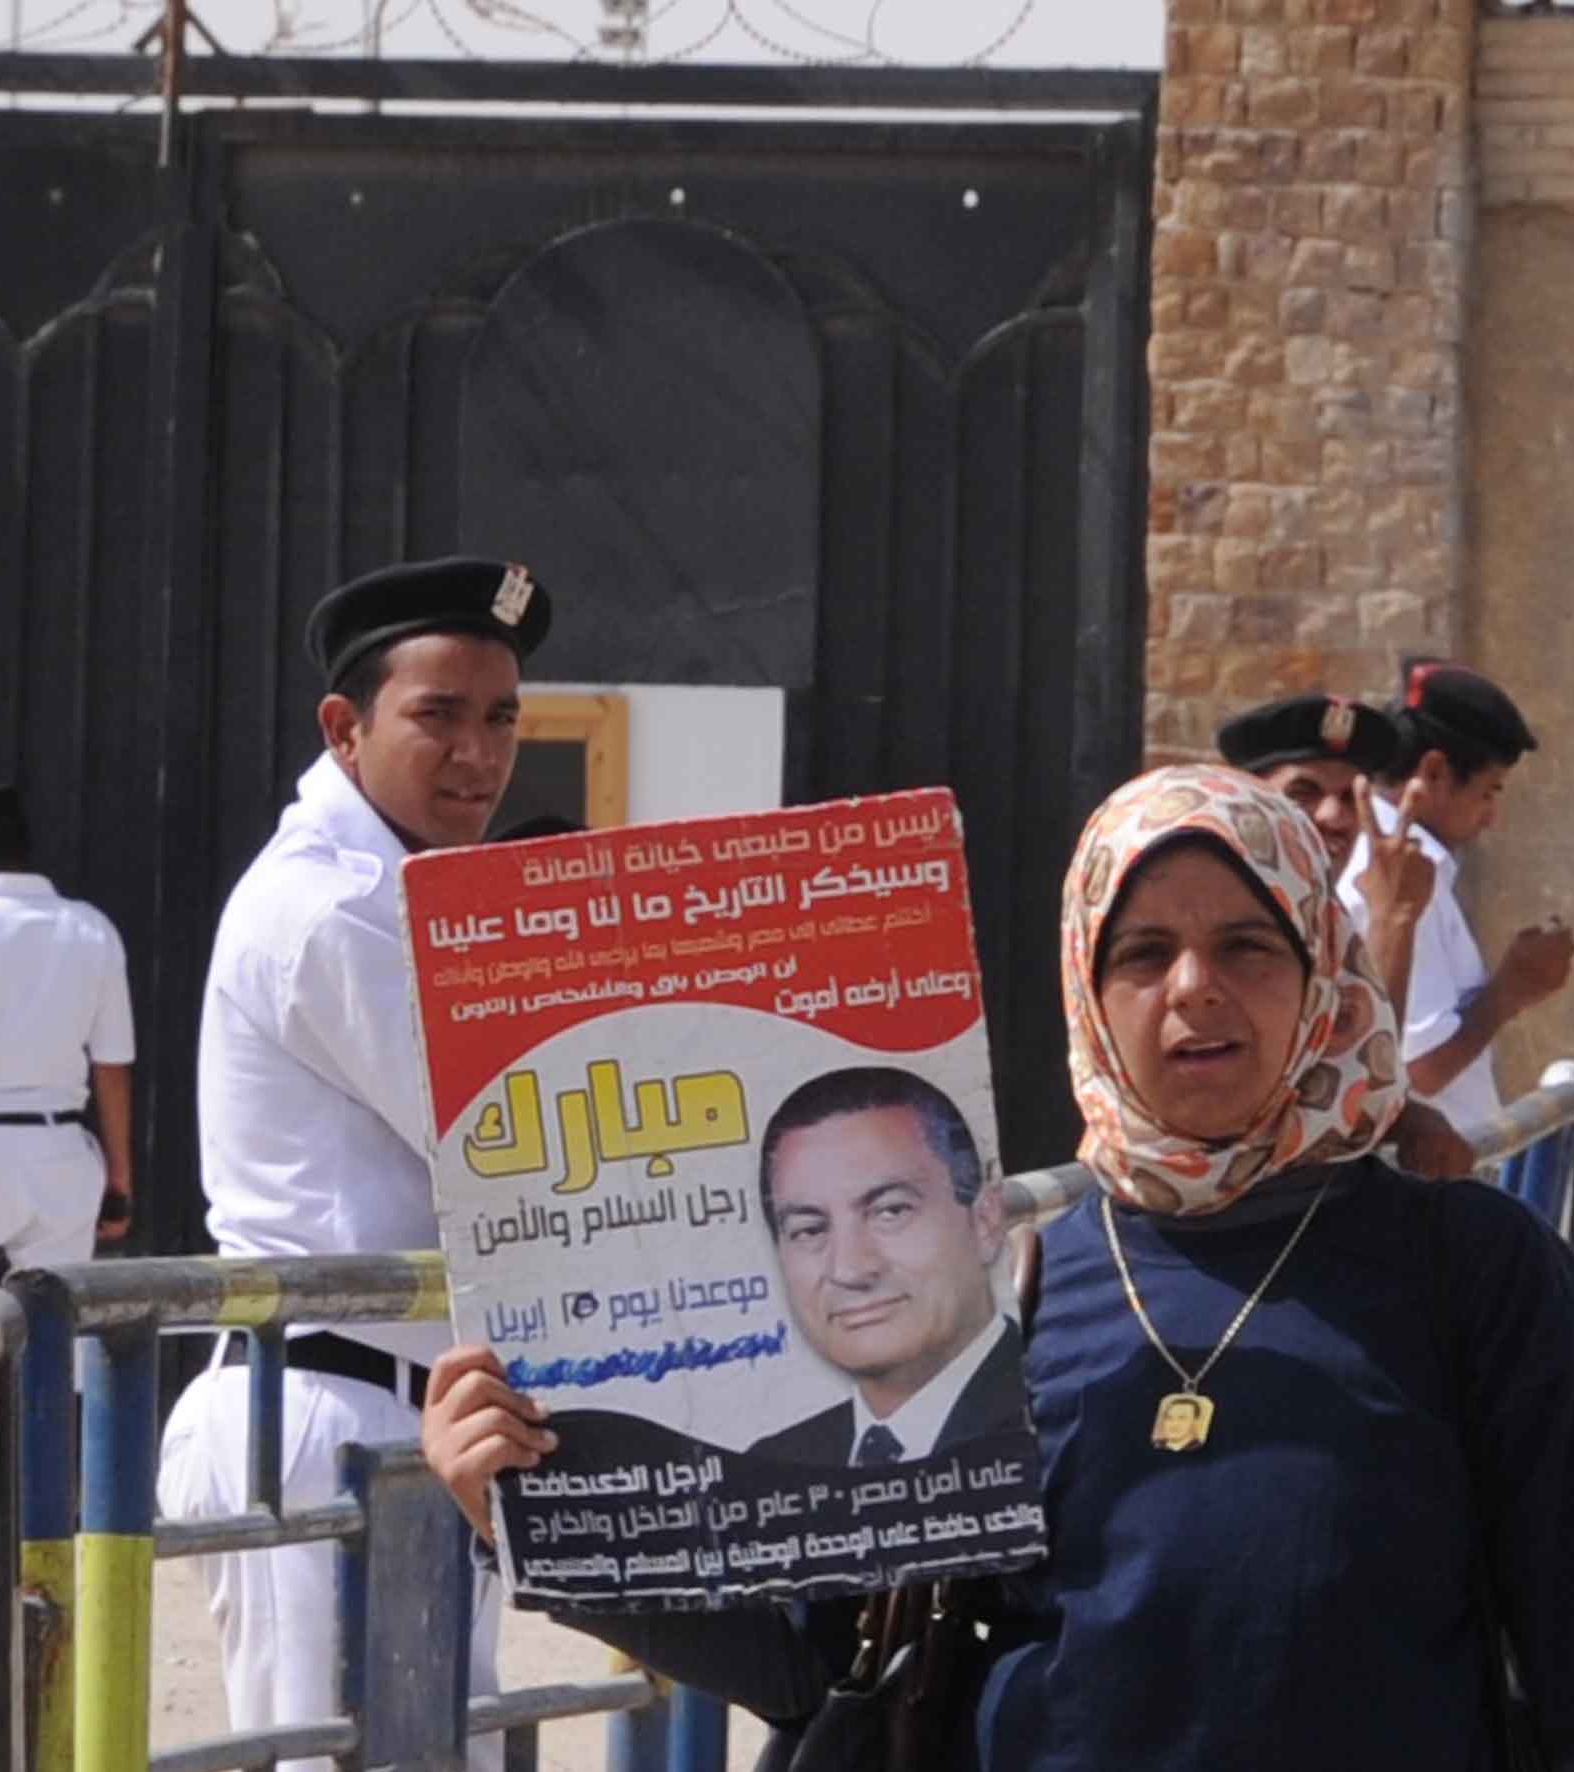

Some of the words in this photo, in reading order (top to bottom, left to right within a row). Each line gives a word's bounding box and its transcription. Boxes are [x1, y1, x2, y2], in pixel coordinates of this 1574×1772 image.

[625, 838, 702, 873] خيانة
[819, 819, 865, 854] من
[684, 873, 785, 923] التاريخ
[799, 858, 950, 909] وسيذكر
[515, 907, 579, 940] وما
[588, 895, 622, 927] لنا
[633, 892, 673, 921] ما
[429, 914, 506, 952] علينا
[695, 961, 766, 989] الوطن
[844, 966, 901, 1008] أرضه
[905, 968, 972, 999] وعلى
[774, 974, 839, 1019] أموت
[463, 1058, 750, 1195] مبارك
[581, 1187, 676, 1245] السلام
[687, 1184, 747, 1228] رجل
[471, 1197, 571, 1256] والأمن
[608, 1289, 661, 1332] يوم
[668, 1274, 769, 1315] موعدنا
[655, 1455, 723, 1496] الرجل
[915, 1457, 961, 1503] أمن
[969, 1459, 1023, 1490] على
[707, 1499, 747, 1531] من
[757, 1490, 802, 1528] عام
[809, 1484, 843, 1510] ٣٠
[851, 1478, 907, 1515] مصر
[528, 1509, 614, 1543] والخارج
[619, 1501, 700, 1539] الداخل
